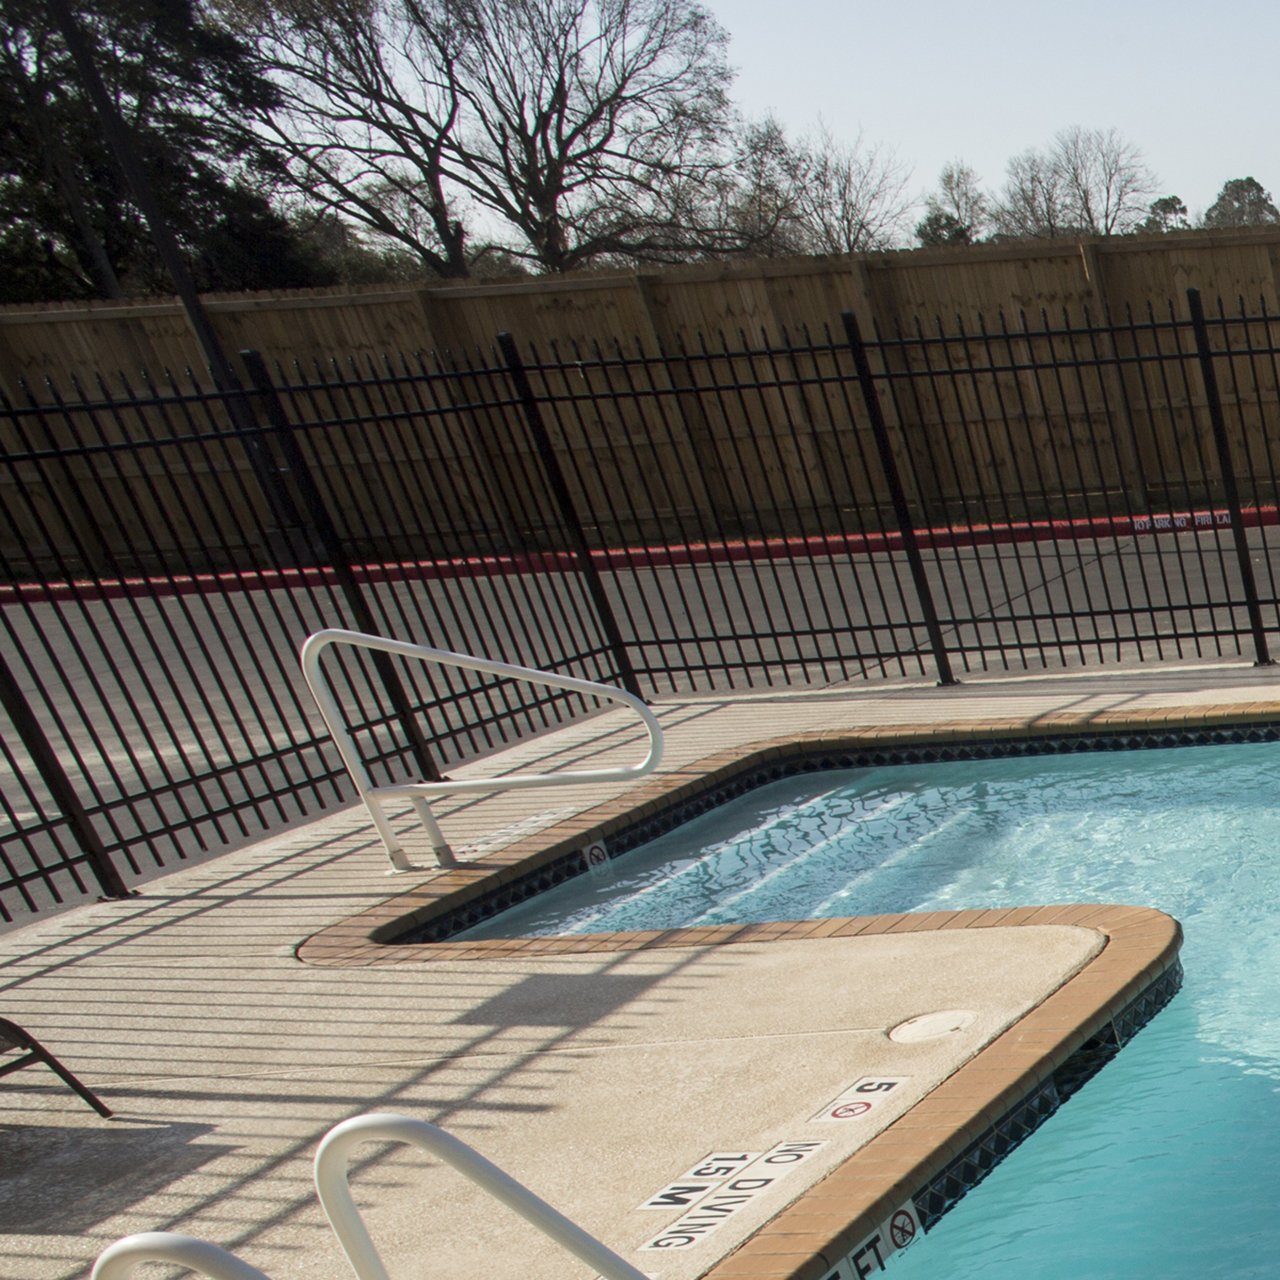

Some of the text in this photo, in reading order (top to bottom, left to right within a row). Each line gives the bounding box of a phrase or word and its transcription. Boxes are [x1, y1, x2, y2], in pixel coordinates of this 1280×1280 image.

[856, 1082, 899, 1093] 5
[647, 1153, 748, 1206] 1.5 M
[648, 1142, 822, 1248] NO DIVING
